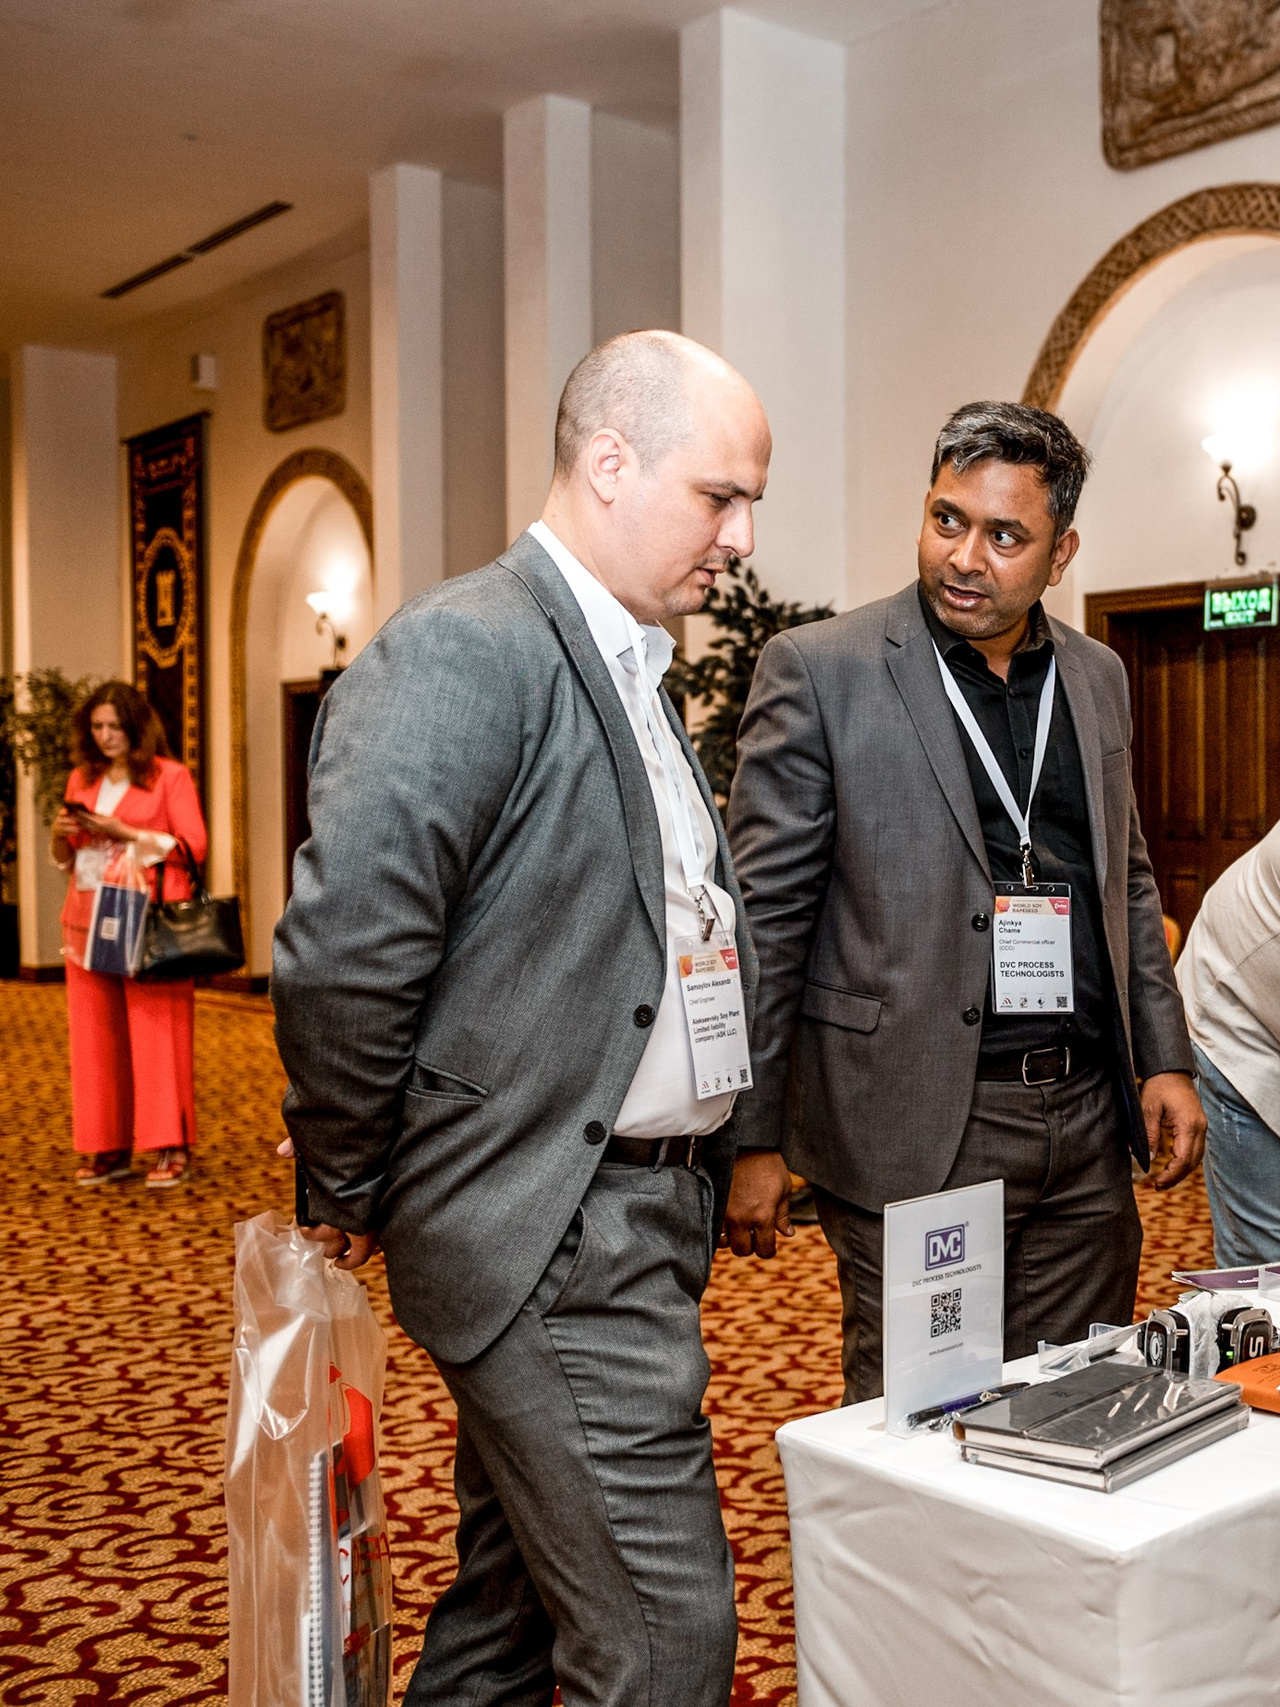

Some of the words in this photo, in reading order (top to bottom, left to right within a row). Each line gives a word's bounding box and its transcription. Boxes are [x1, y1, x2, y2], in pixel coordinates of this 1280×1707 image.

[1211, 587, 1271, 614] ВЫХОД
[1000, 961, 1016, 969] DVC
[1018, 961, 1055, 969] PROCESS
[1000, 970, 1065, 978] TECHNOLOGISTS
[929, 1230, 961, 1264] DVC
[922, 1272, 944, 1284] PROCESS
[944, 1263, 982, 1279] TECHNOLOGISTS
